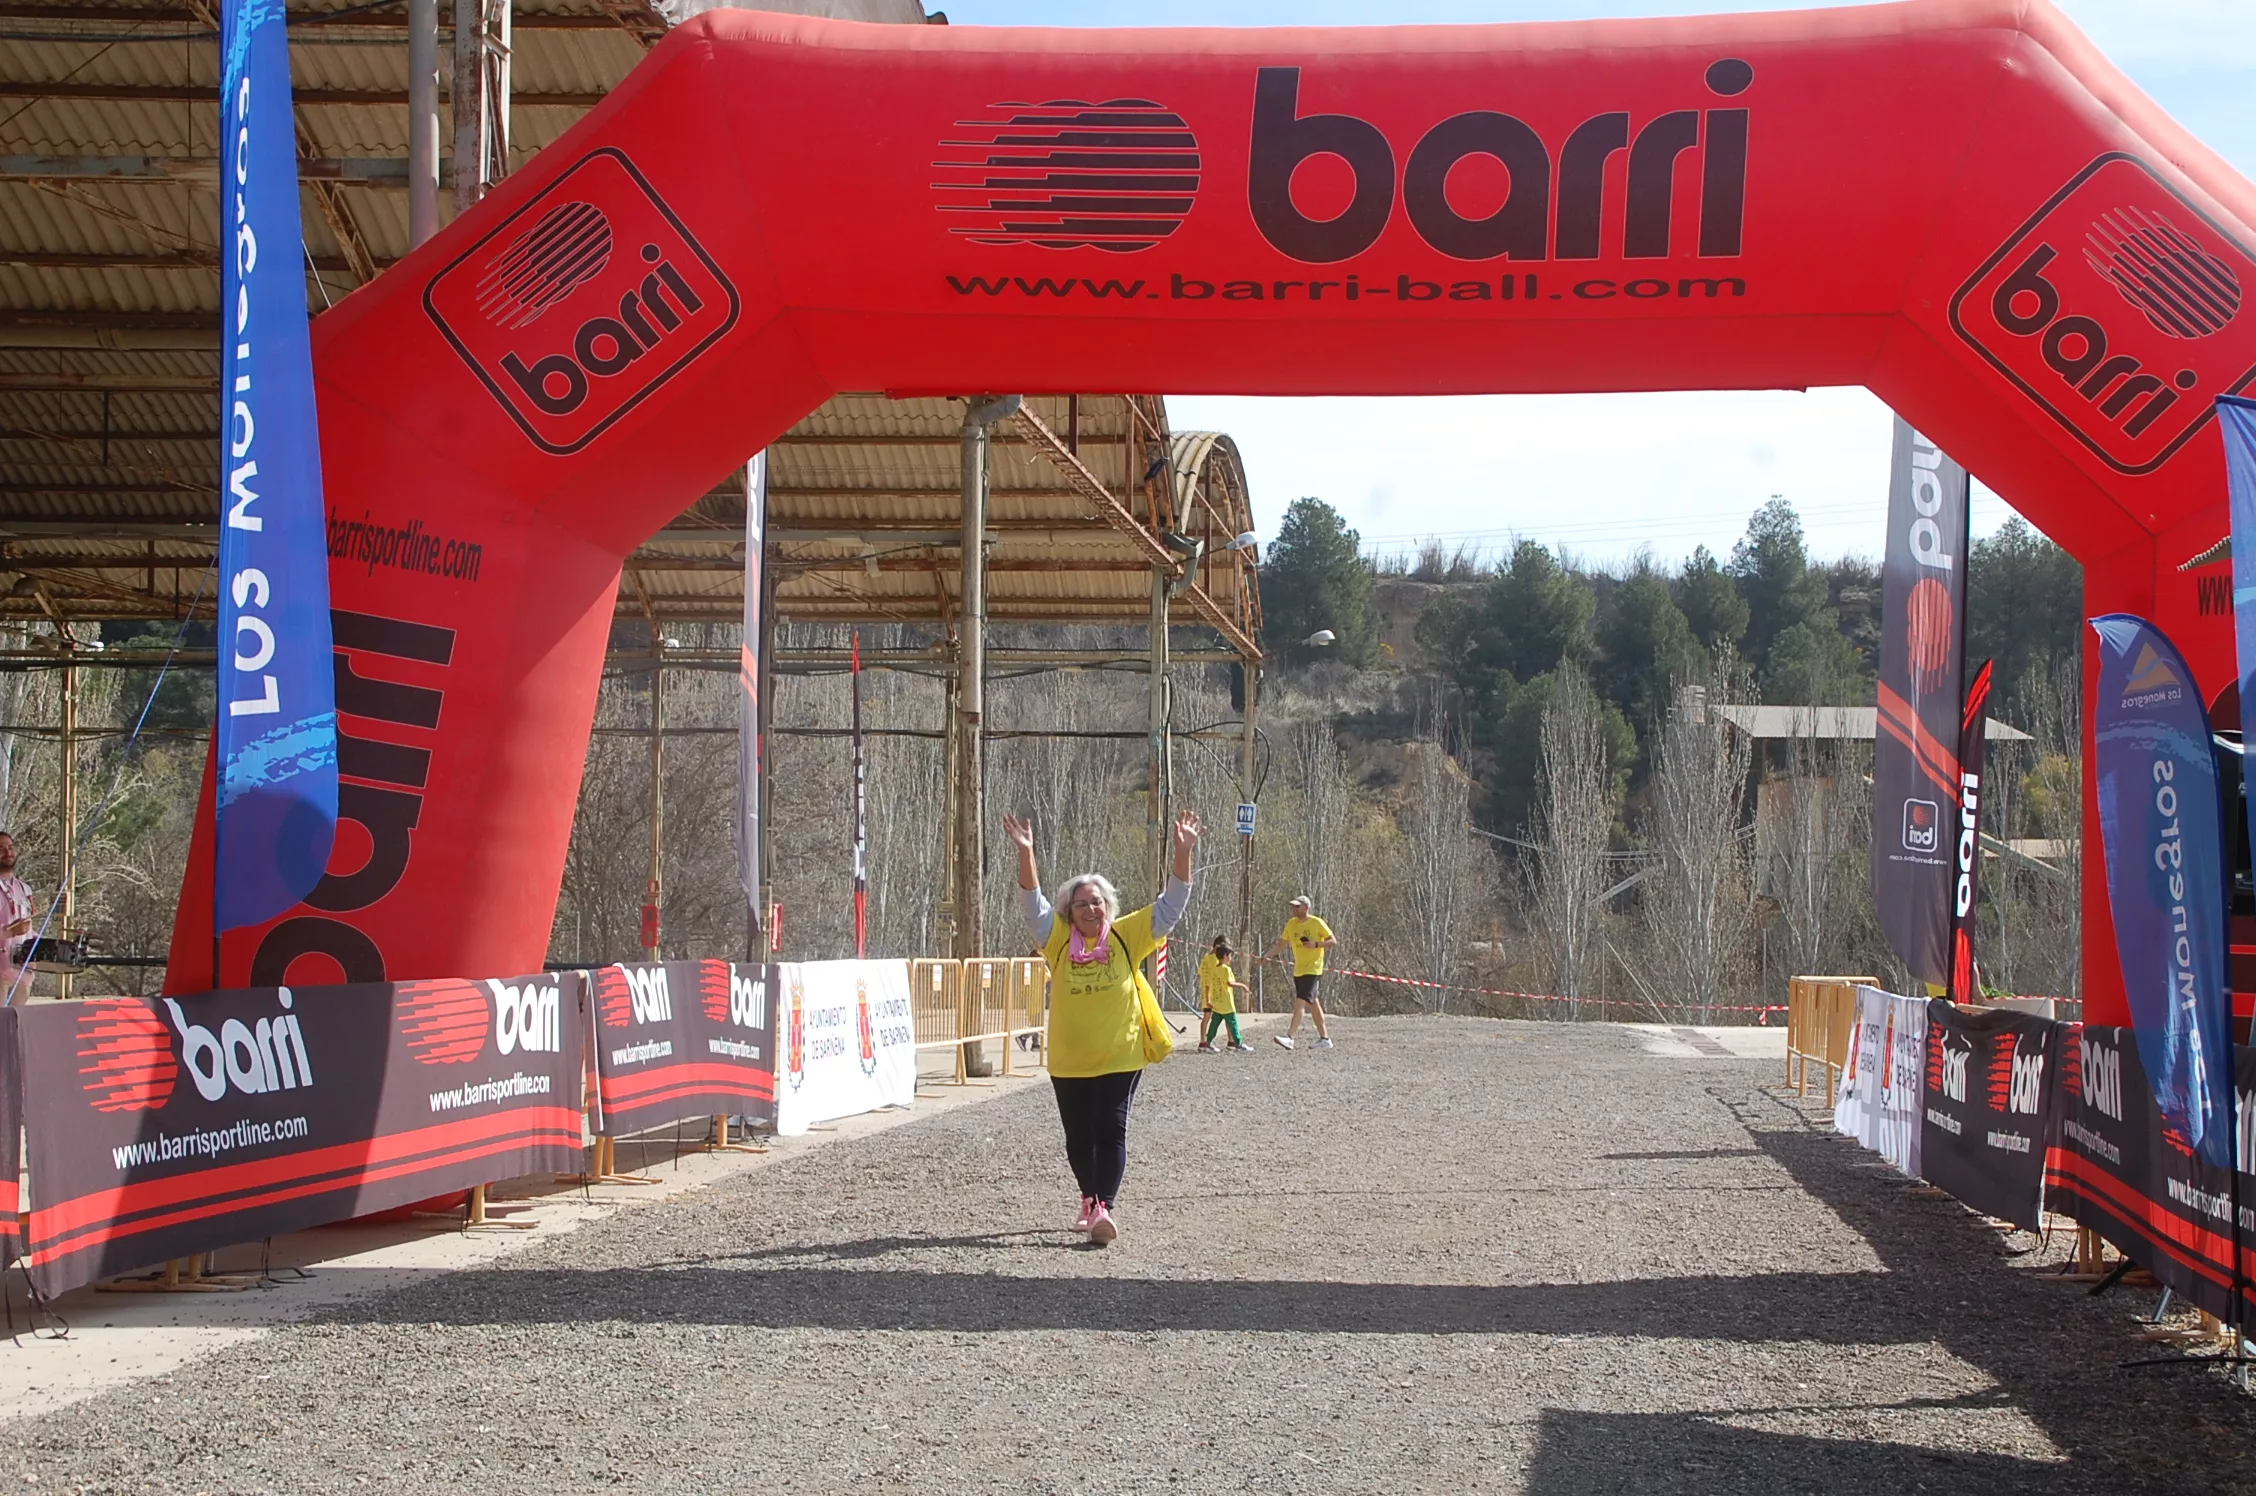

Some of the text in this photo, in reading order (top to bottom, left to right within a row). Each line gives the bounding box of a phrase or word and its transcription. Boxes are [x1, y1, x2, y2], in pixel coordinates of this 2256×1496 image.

[1247, 58, 1754, 265] barri
[946, 273, 1746, 301] www.barri-ball.com
[498, 243, 705, 416] barri
[1991, 241, 2197, 440] barri
[326, 504, 483, 582] barrisportline.com
[485, 972, 560, 1055] barri
[729, 962, 765, 1030] barri
[162, 986, 314, 1101] barri
[112, 1116, 308, 1170] www.barrisportline.com
